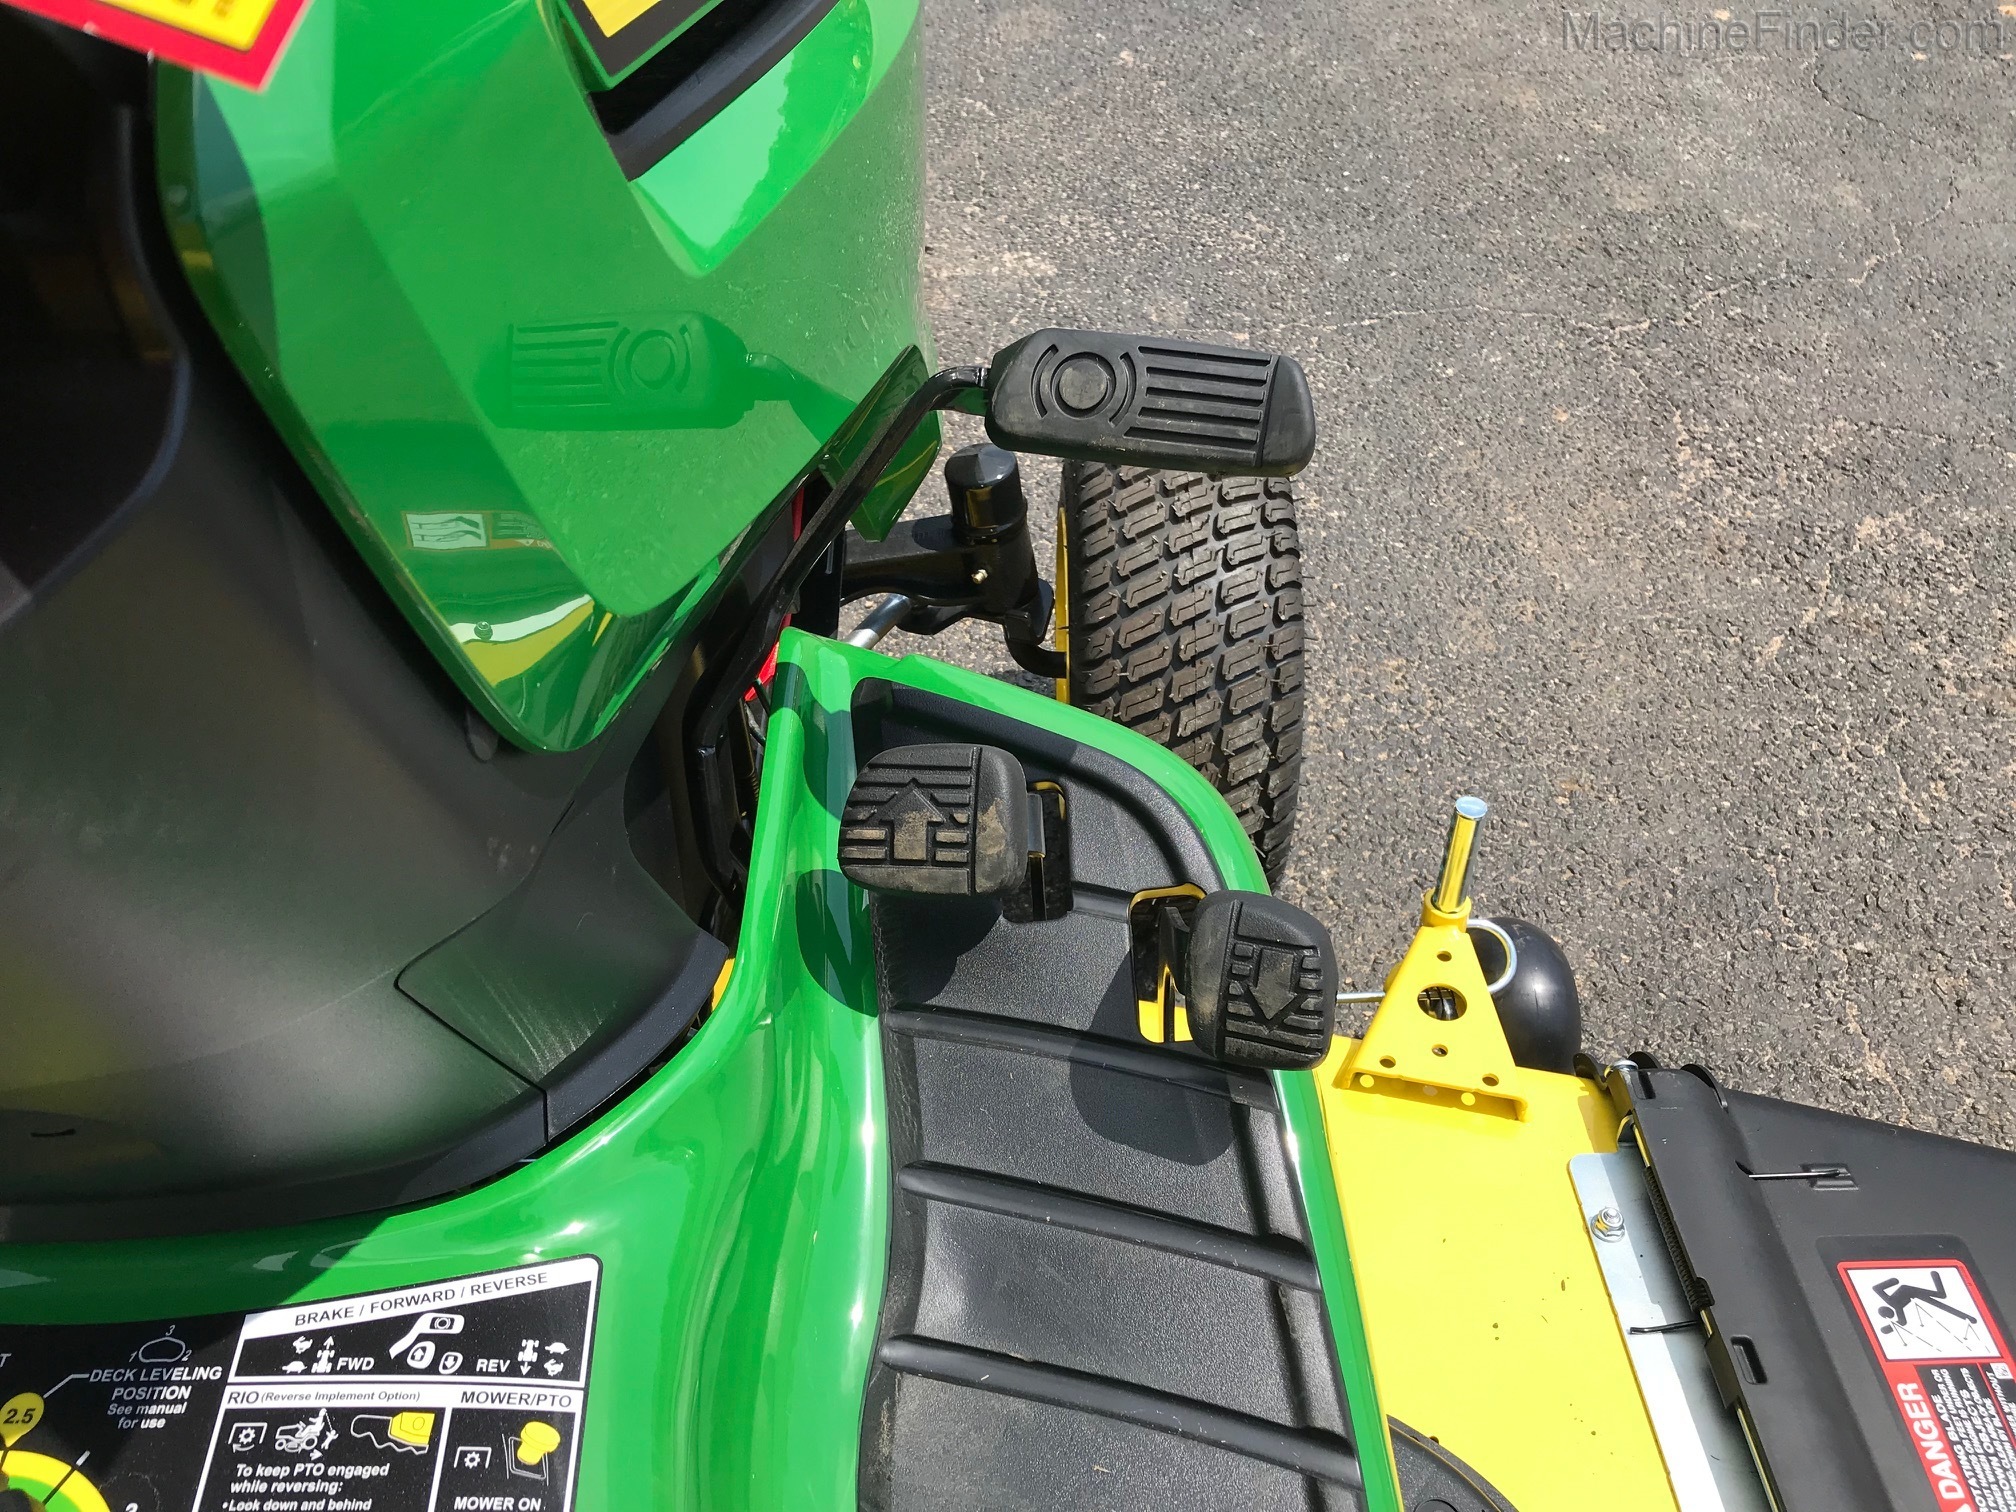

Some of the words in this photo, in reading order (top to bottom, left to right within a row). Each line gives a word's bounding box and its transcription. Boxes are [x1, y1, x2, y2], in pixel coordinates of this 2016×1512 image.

[295, 1306, 355, 1327] BRAKE
[370, 1288, 456, 1314] FORWARD
[470, 1271, 549, 1296] REVERSE
[166, 1325, 175, 1336] 3
[129, 1352, 137, 1362] 1
[182, 1350, 192, 1362] 2
[336, 1357, 375, 1371] FWD
[89, 1368, 136, 1382] DECK
[140, 1366, 223, 1381] LEVELING
[476, 1359, 511, 1373] REV
[1931, 1369, 1943, 1382] OR
[112, 1385, 192, 1400] POSITION
[1940, 1369, 1965, 1408] RUNNING
[1960, 1368, 1983, 1404] OBJECTS
[1986, 1371, 2009, 1413] WITHOUT
[226, 1391, 260, 1405] RIO
[261, 1391, 312, 1404] (Reverse
[314, 1391, 375, 1402] Implement
[378, 1391, 421, 1402] Option)
[460, 1391, 572, 1408] MOWER/PTO
[1937, 1384, 1957, 1414] UNDER
[3, 1408, 35, 1424] 2.5
[107, 1403, 132, 1415] See
[136, 1402, 187, 1414] manual
[1958, 1409, 1969, 1419] IS
[1976, 1405, 1988, 1416] OF
[1982, 1398, 2003, 1427] BLADE
[118, 1417, 135, 1429] for
[141, 1418, 166, 1429] use
[1931, 1394, 1960, 1441] BLADE
[1959, 1389, 1995, 1453] OBJECTS
[1951, 1415, 1968, 1438] FEET
[1982, 1417, 1999, 1440] AREA
[1897, 1383, 1965, 1499] DANGER
[1962, 1420, 1984, 1453] ENGINE
[1962, 1440, 1974, 1453] OR
[1993, 1441, 2010, 1468] CLEAR
[236, 1464, 252, 1478] To
[256, 1464, 290, 1480] keep
[293, 1463, 326, 1477] PTO
[327, 1463, 390, 1480] engaged
[1969, 1455, 1989, 1487] HANDS
[1978, 1455, 1995, 1482] WHEN
[230, 1480, 267, 1494] while
[270, 1480, 343, 1495] reversing:
[263, 1499, 297, 1512] down
[299, 1499, 325, 1511] and
[328, 1498, 372, 1511] behind
[454, 1496, 515, 1511] MOWER
[518, 1498, 541, 1511] ON
[1982, 1487, 1997, 1507] PUT
